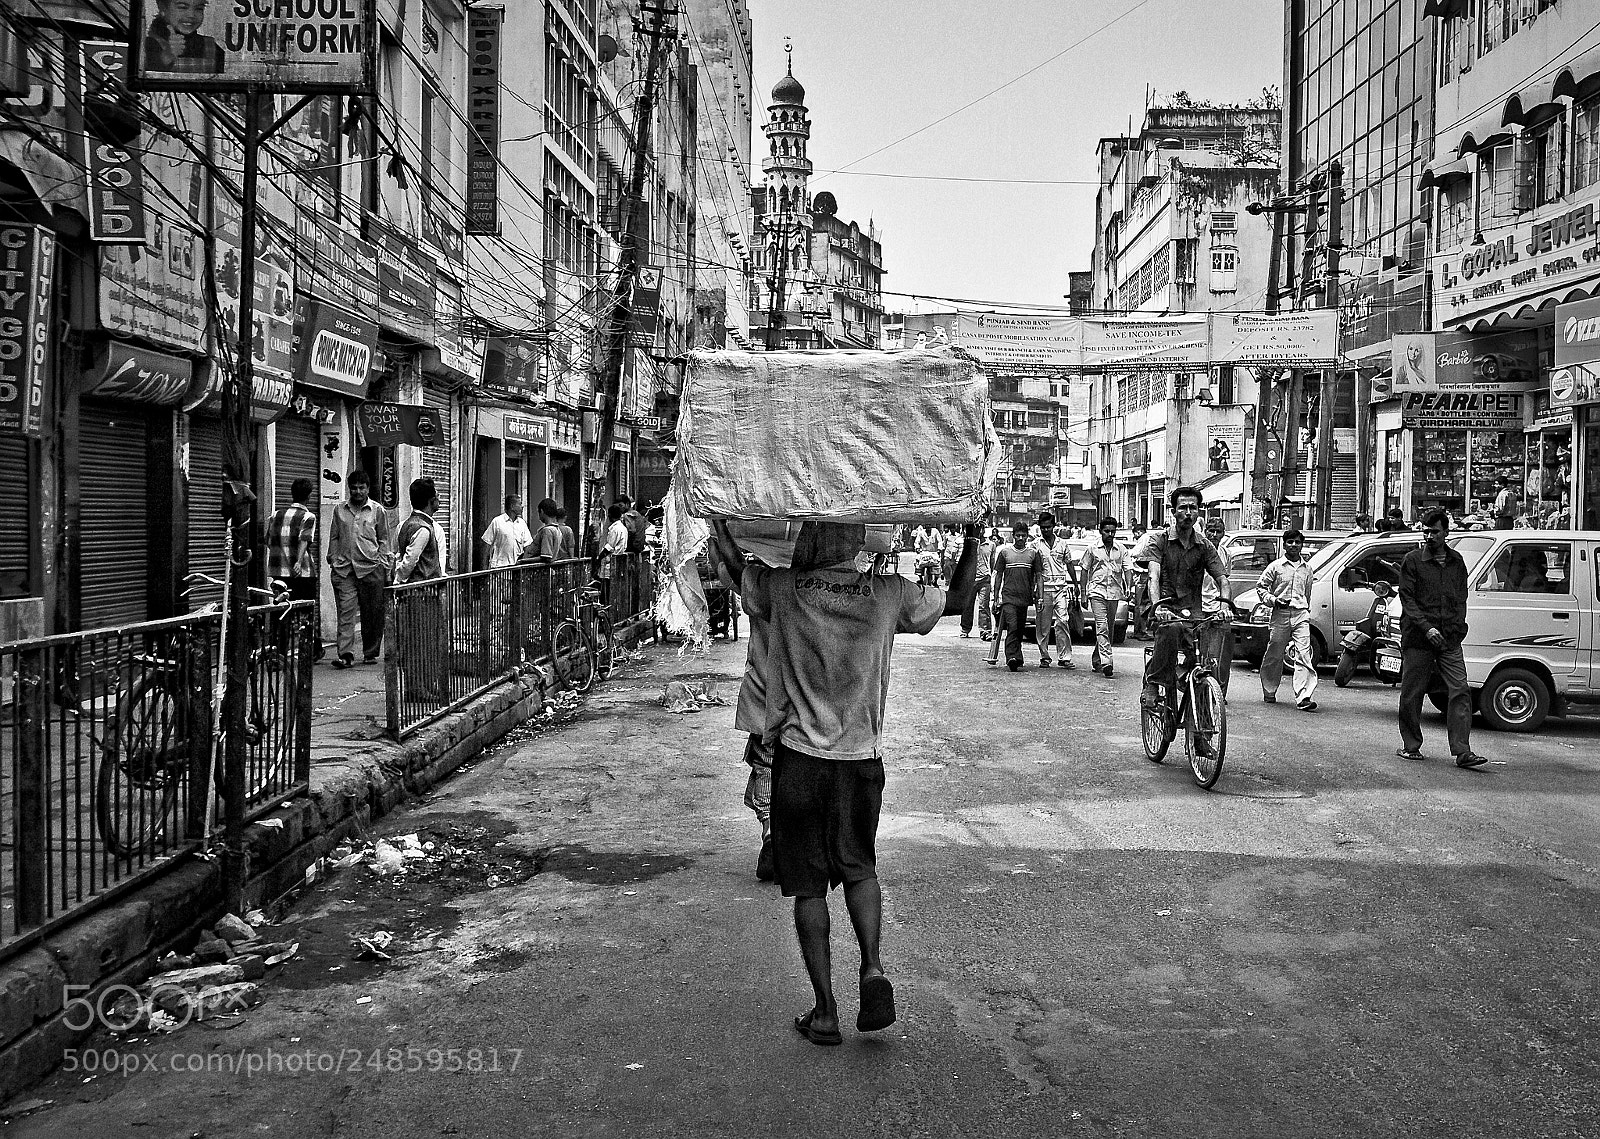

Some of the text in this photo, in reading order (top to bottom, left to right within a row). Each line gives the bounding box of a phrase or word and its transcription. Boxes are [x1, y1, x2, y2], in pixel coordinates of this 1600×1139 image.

[233, 0, 356, 18] SCHOOL
[225, 22, 361, 54] UNIFORM
[470, 29, 496, 157] FOOD XPRESS
[96, 144, 132, 234] GOLD
[300, 217, 326, 246] TIMEX
[0, 228, 27, 311] CITY
[329, 242, 357, 271] TITAN
[1461, 235, 1519, 281] GOPAL
[38, 236, 52, 316] CITY
[0, 316, 23, 402] GOLD
[31, 322, 46, 407] GOLD
[1436, 350, 1472, 368] Barbie
[252, 375, 292, 408] TRADERS
[364, 404, 398, 414] SWAP
[366, 415, 400, 424] YOUR
[638, 418, 658, 426] GOLD
[368, 424, 402, 434] STYLE
